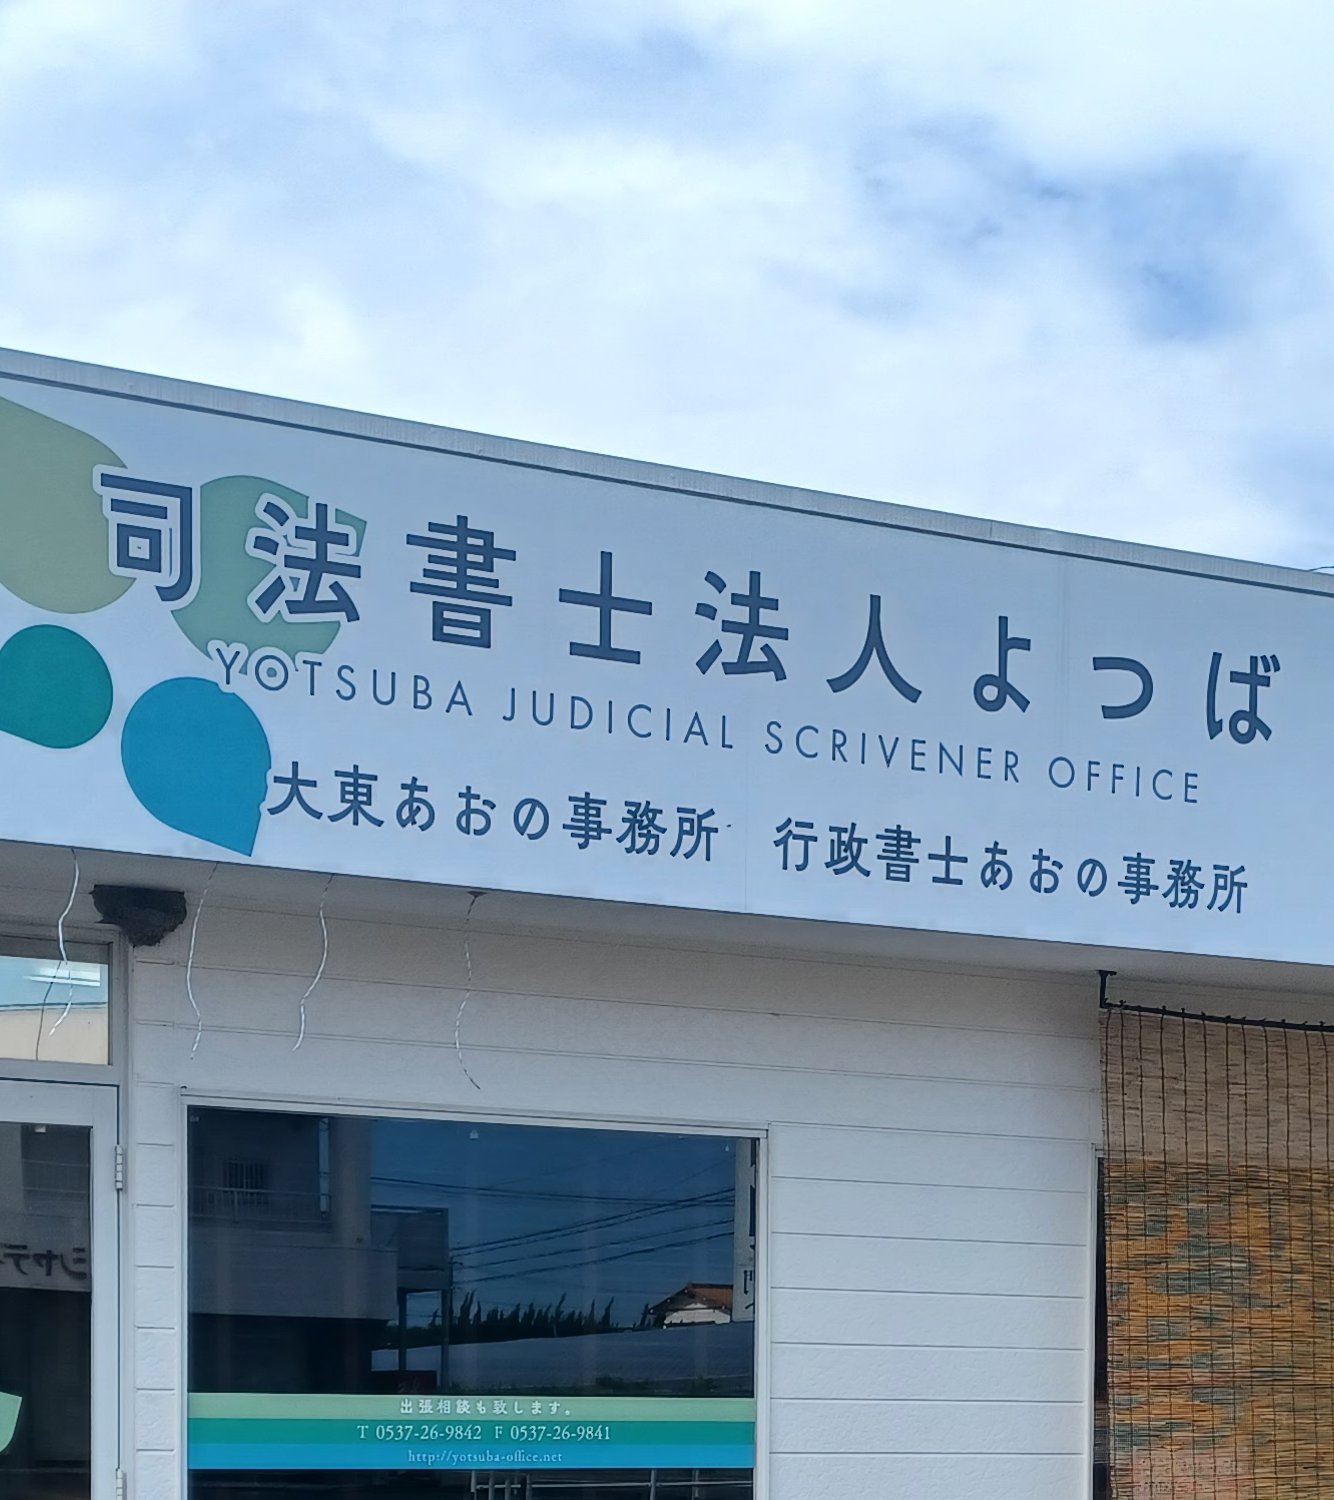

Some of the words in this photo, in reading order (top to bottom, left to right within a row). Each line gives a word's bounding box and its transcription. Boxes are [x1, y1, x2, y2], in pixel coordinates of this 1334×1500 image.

[99, 472, 1281, 745] 司法書士法人よつば
[214, 647, 474, 716] YOTSUBA
[502, 688, 734, 750] JUDICIAL
[764, 721, 1020, 784] SCRIVENER
[1048, 756, 1199, 804] OFFICE
[268, 761, 720, 862] 大東あおの事務所
[773, 816, 1249, 914] 行政書士あおの事務所
[357, 1425, 369, 1439] T
[375, 1424, 482, 1441] 0537-26-9842
[494, 1426, 503, 1439] F
[510, 1424, 611, 1441] 0537-26-9841
[400, 1399, 572, 1415] 出張相談も致します。
[408, 1450, 563, 1466] http://yotsuba-office.net
